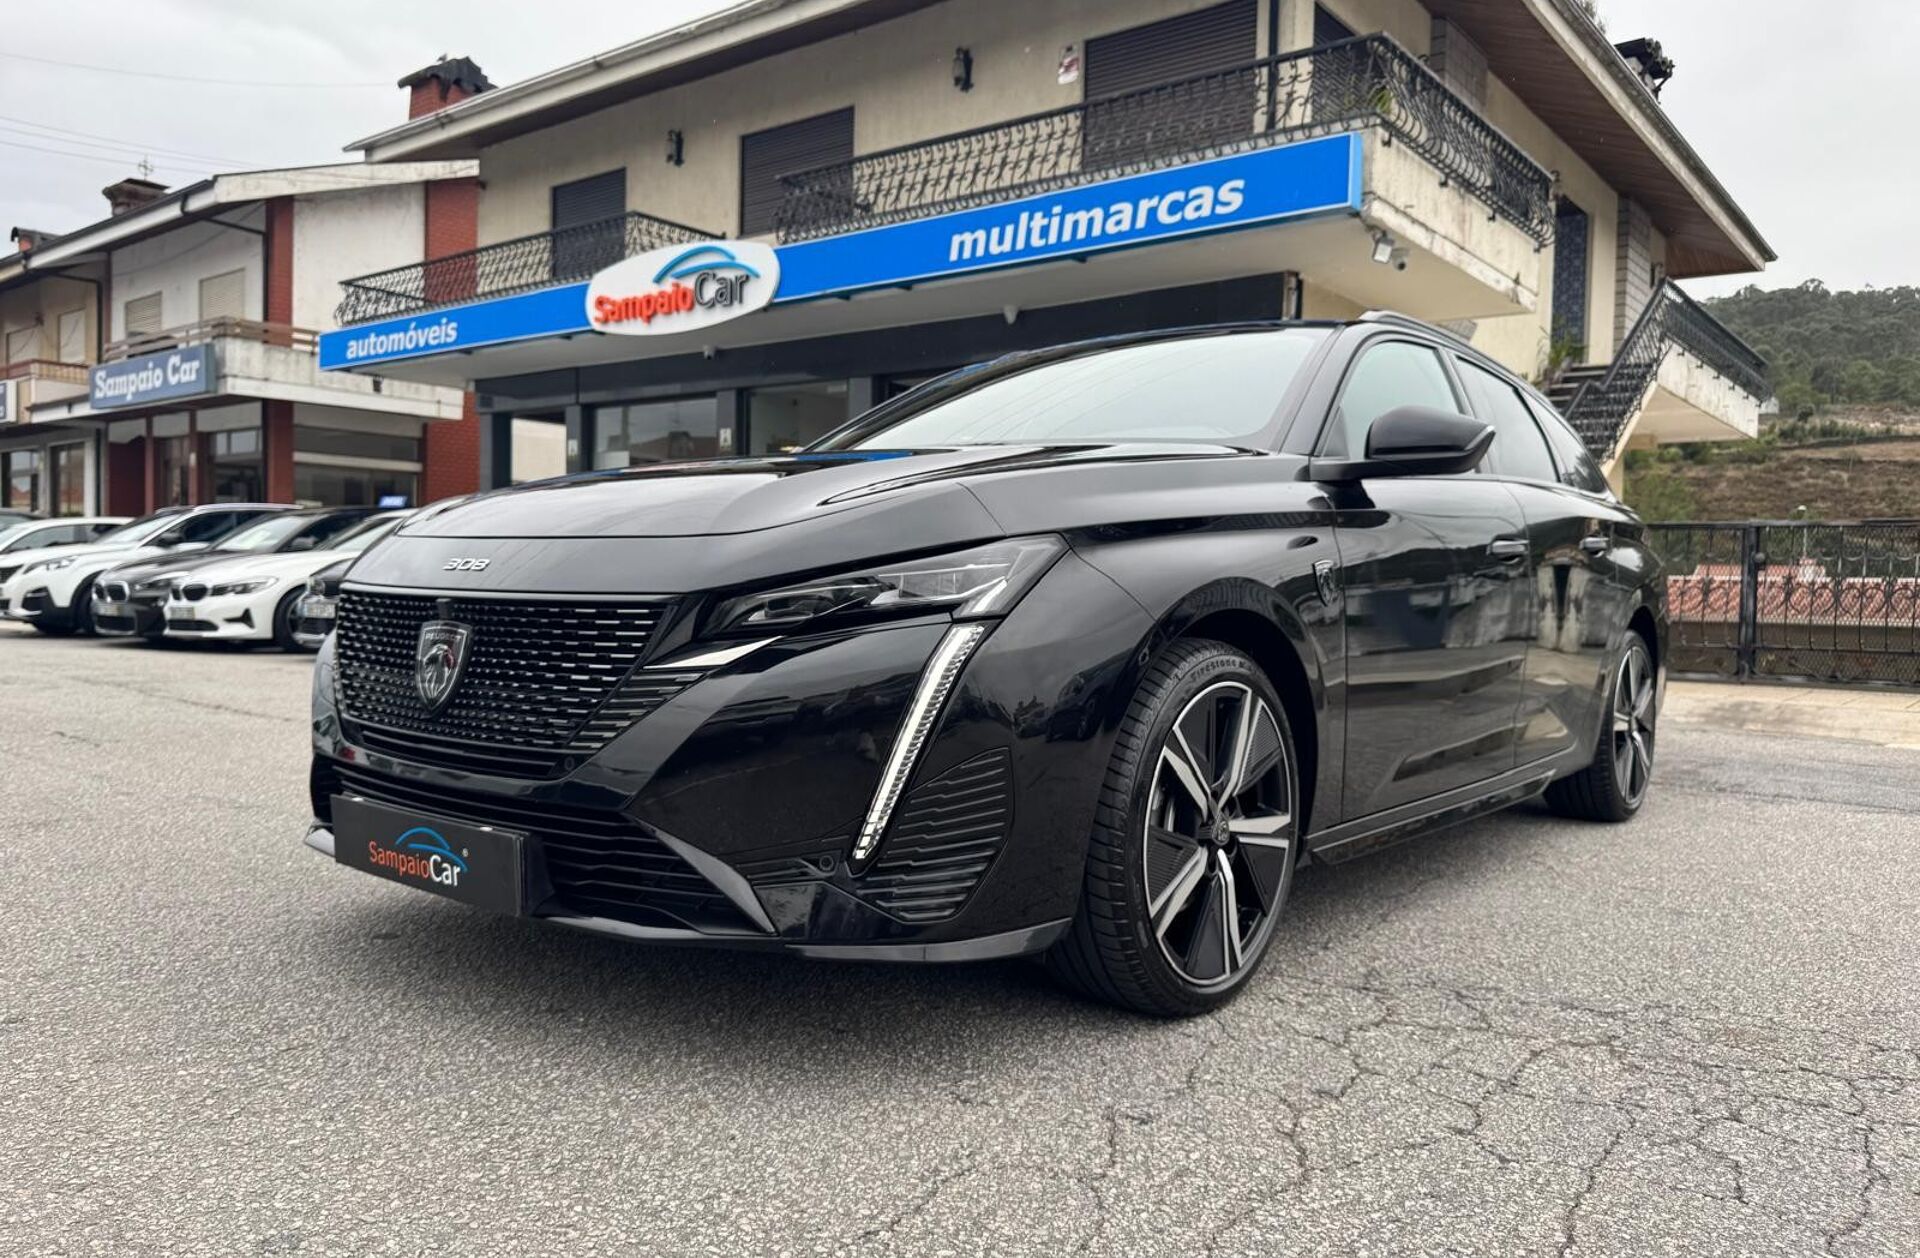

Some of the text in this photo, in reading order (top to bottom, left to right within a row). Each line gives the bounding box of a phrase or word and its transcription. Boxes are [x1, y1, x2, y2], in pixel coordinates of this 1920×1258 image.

[949, 179, 1245, 262] multimarcas
[594, 271, 751, 325] SampaioCar
[346, 317, 458, 360] automóveis
[94, 354, 200, 401] Sampaio Car
[442, 557, 490, 571] 308
[368, 840, 461, 886] SampaioCar
